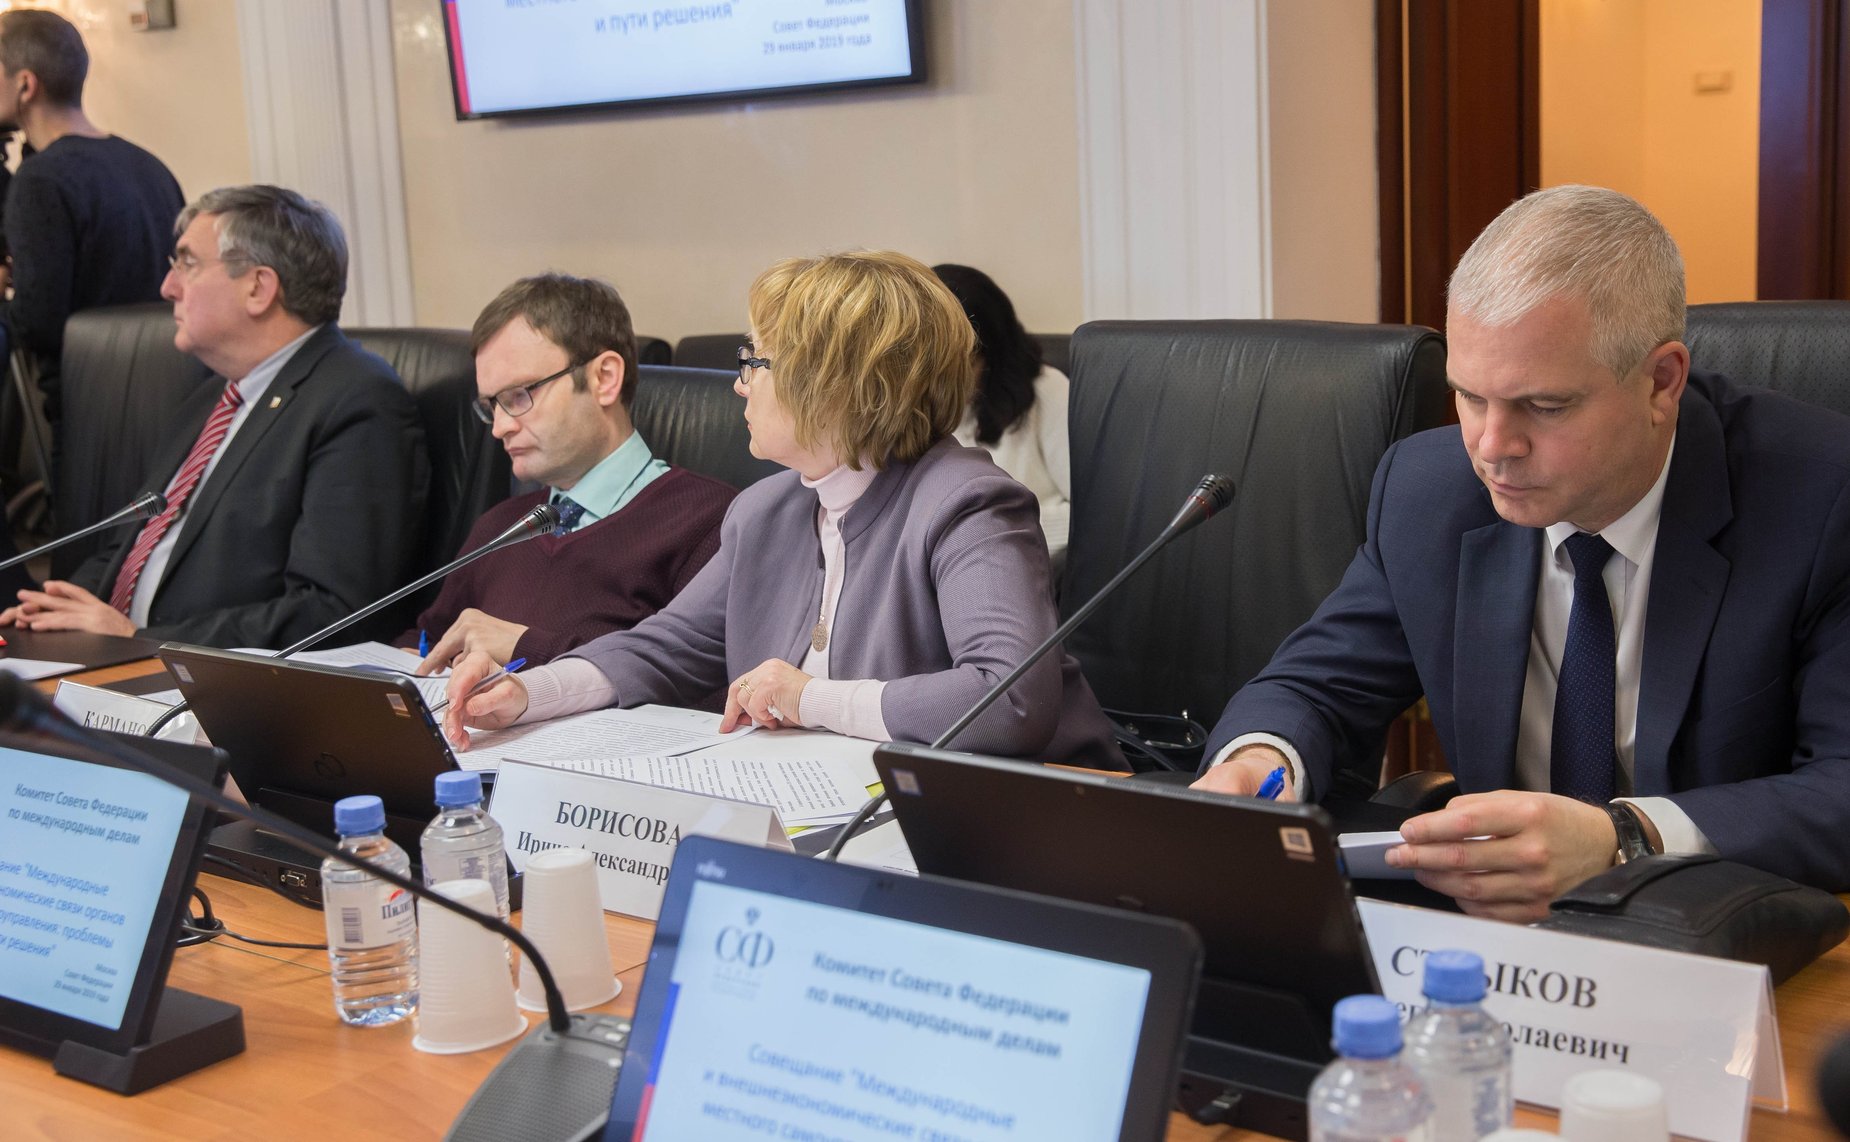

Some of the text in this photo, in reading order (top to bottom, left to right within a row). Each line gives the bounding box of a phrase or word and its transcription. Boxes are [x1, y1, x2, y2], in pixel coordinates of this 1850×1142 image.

[594, 1, 741, 34] и пути решения"
[806, 13, 870, 29] Федерации
[778, 39, 816, 52] января
[15, 783, 149, 822] Комитет Совета Федерации
[8, 807, 142, 845] по международным делам
[555, 801, 682, 848] БОРИСОВА
[516, 830, 569, 855] Ири
[581, 843, 670, 886] лександр
[55, 899, 84, 915] связи
[85, 906, 126, 926] органов
[63, 926, 115, 949] проблемы
[715, 925, 775, 968] СФ
[813, 952, 1070, 1027] Комитет Совета Федерации
[1391, 945, 1598, 1009] СЫКОВ
[806, 984, 1062, 1060] по международным делам
[1502, 1021, 1630, 1064] олаевич
[702, 1069, 714, 1083] и
[717, 1071, 916, 1139] внешнеэкономические
[748, 1043, 1017, 1131] Совещание "Международные
[702, 1100, 778, 1136] местного
